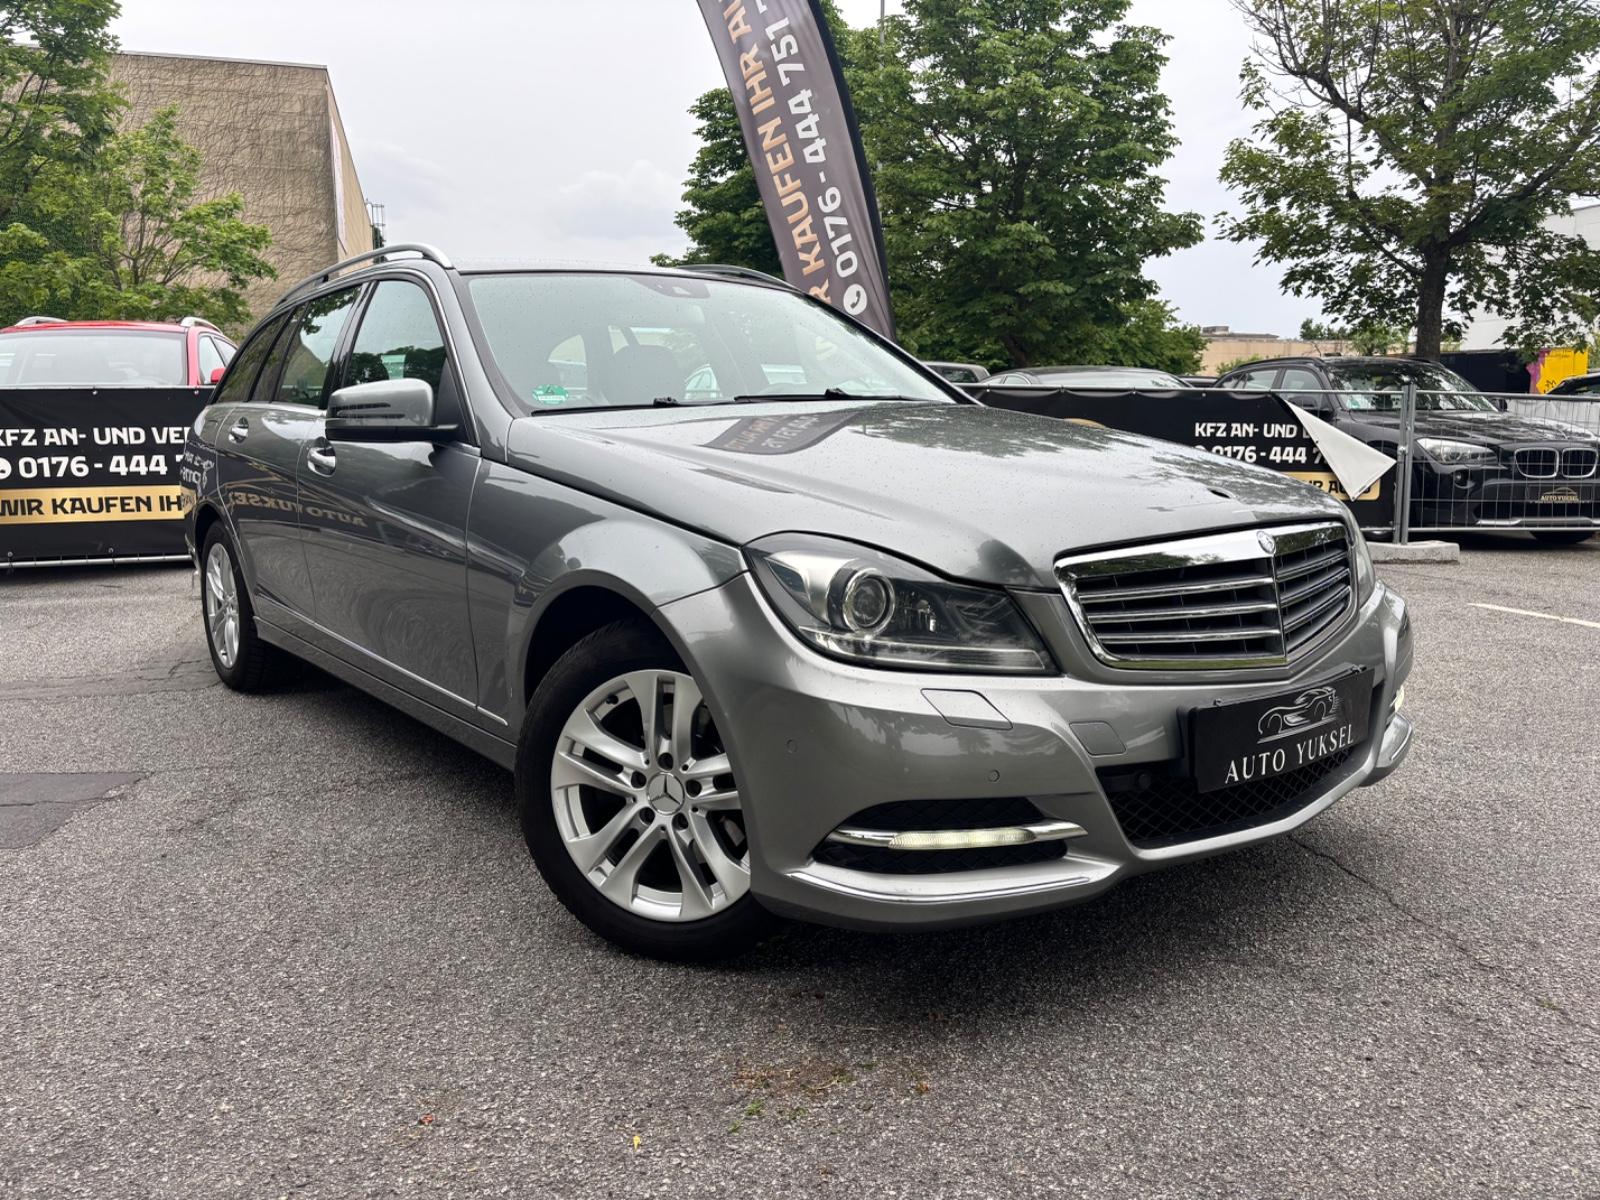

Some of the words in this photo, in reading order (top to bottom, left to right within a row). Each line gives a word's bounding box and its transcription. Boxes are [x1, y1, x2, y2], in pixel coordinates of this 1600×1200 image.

[739, 42, 775, 115] IHR
[765, 17, 805, 87] 751
[788, 88, 827, 164] 444
[758, 116, 825, 276] KAUFEN
[818, 186, 858, 278] 0176
[43, 427, 87, 446] AN-
[93, 427, 146, 446] UND
[1194, 422, 1227, 437] KFZ
[1230, 423, 1260, 437] AN-
[1263, 423, 1297, 438] UND
[1269, 446, 1307, 464] 444
[18, 456, 90, 478] 0176
[109, 454, 168, 476] 444
[52, 496, 152, 515] KAUFEN
[1225, 748, 1286, 784] AUTO
[1296, 724, 1354, 765] YUKSEL
